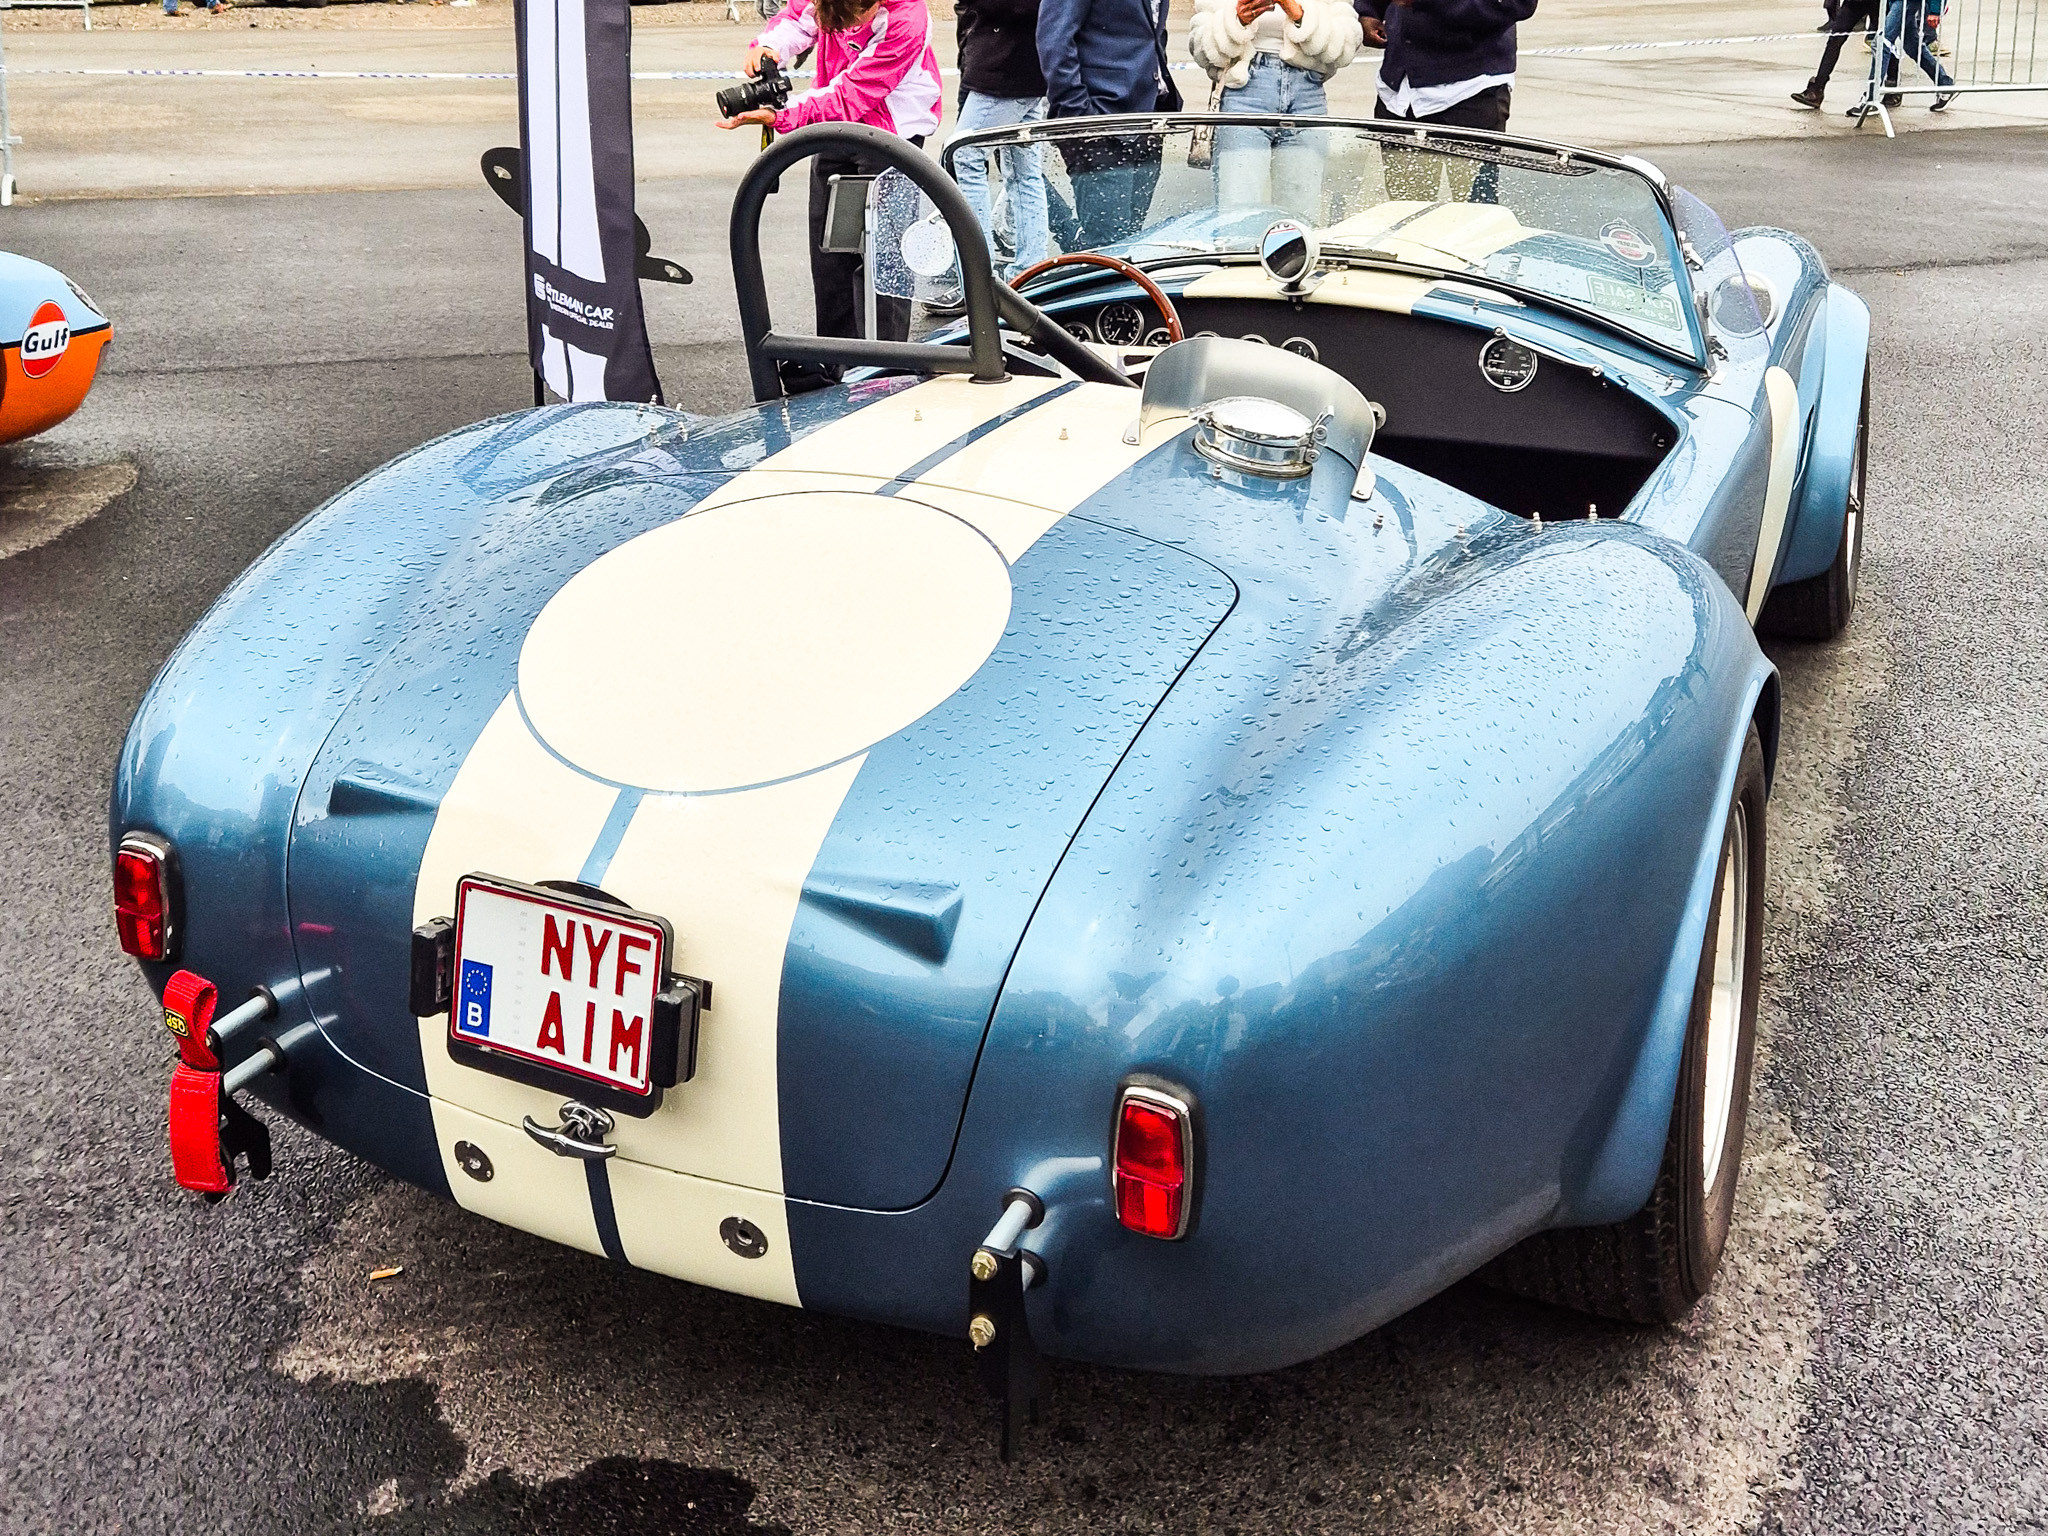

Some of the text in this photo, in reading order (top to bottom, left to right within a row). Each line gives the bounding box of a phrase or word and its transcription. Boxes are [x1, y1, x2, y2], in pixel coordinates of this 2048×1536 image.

[545, 281, 584, 315] GTLEMAN
[584, 304, 614, 321] CAR
[24, 327, 69, 354] Gulf
[588, 318, 614, 330] DEALER
[540, 913, 652, 997] NYF
[466, 1001, 483, 1027] B
[536, 991, 643, 1079] AIM
